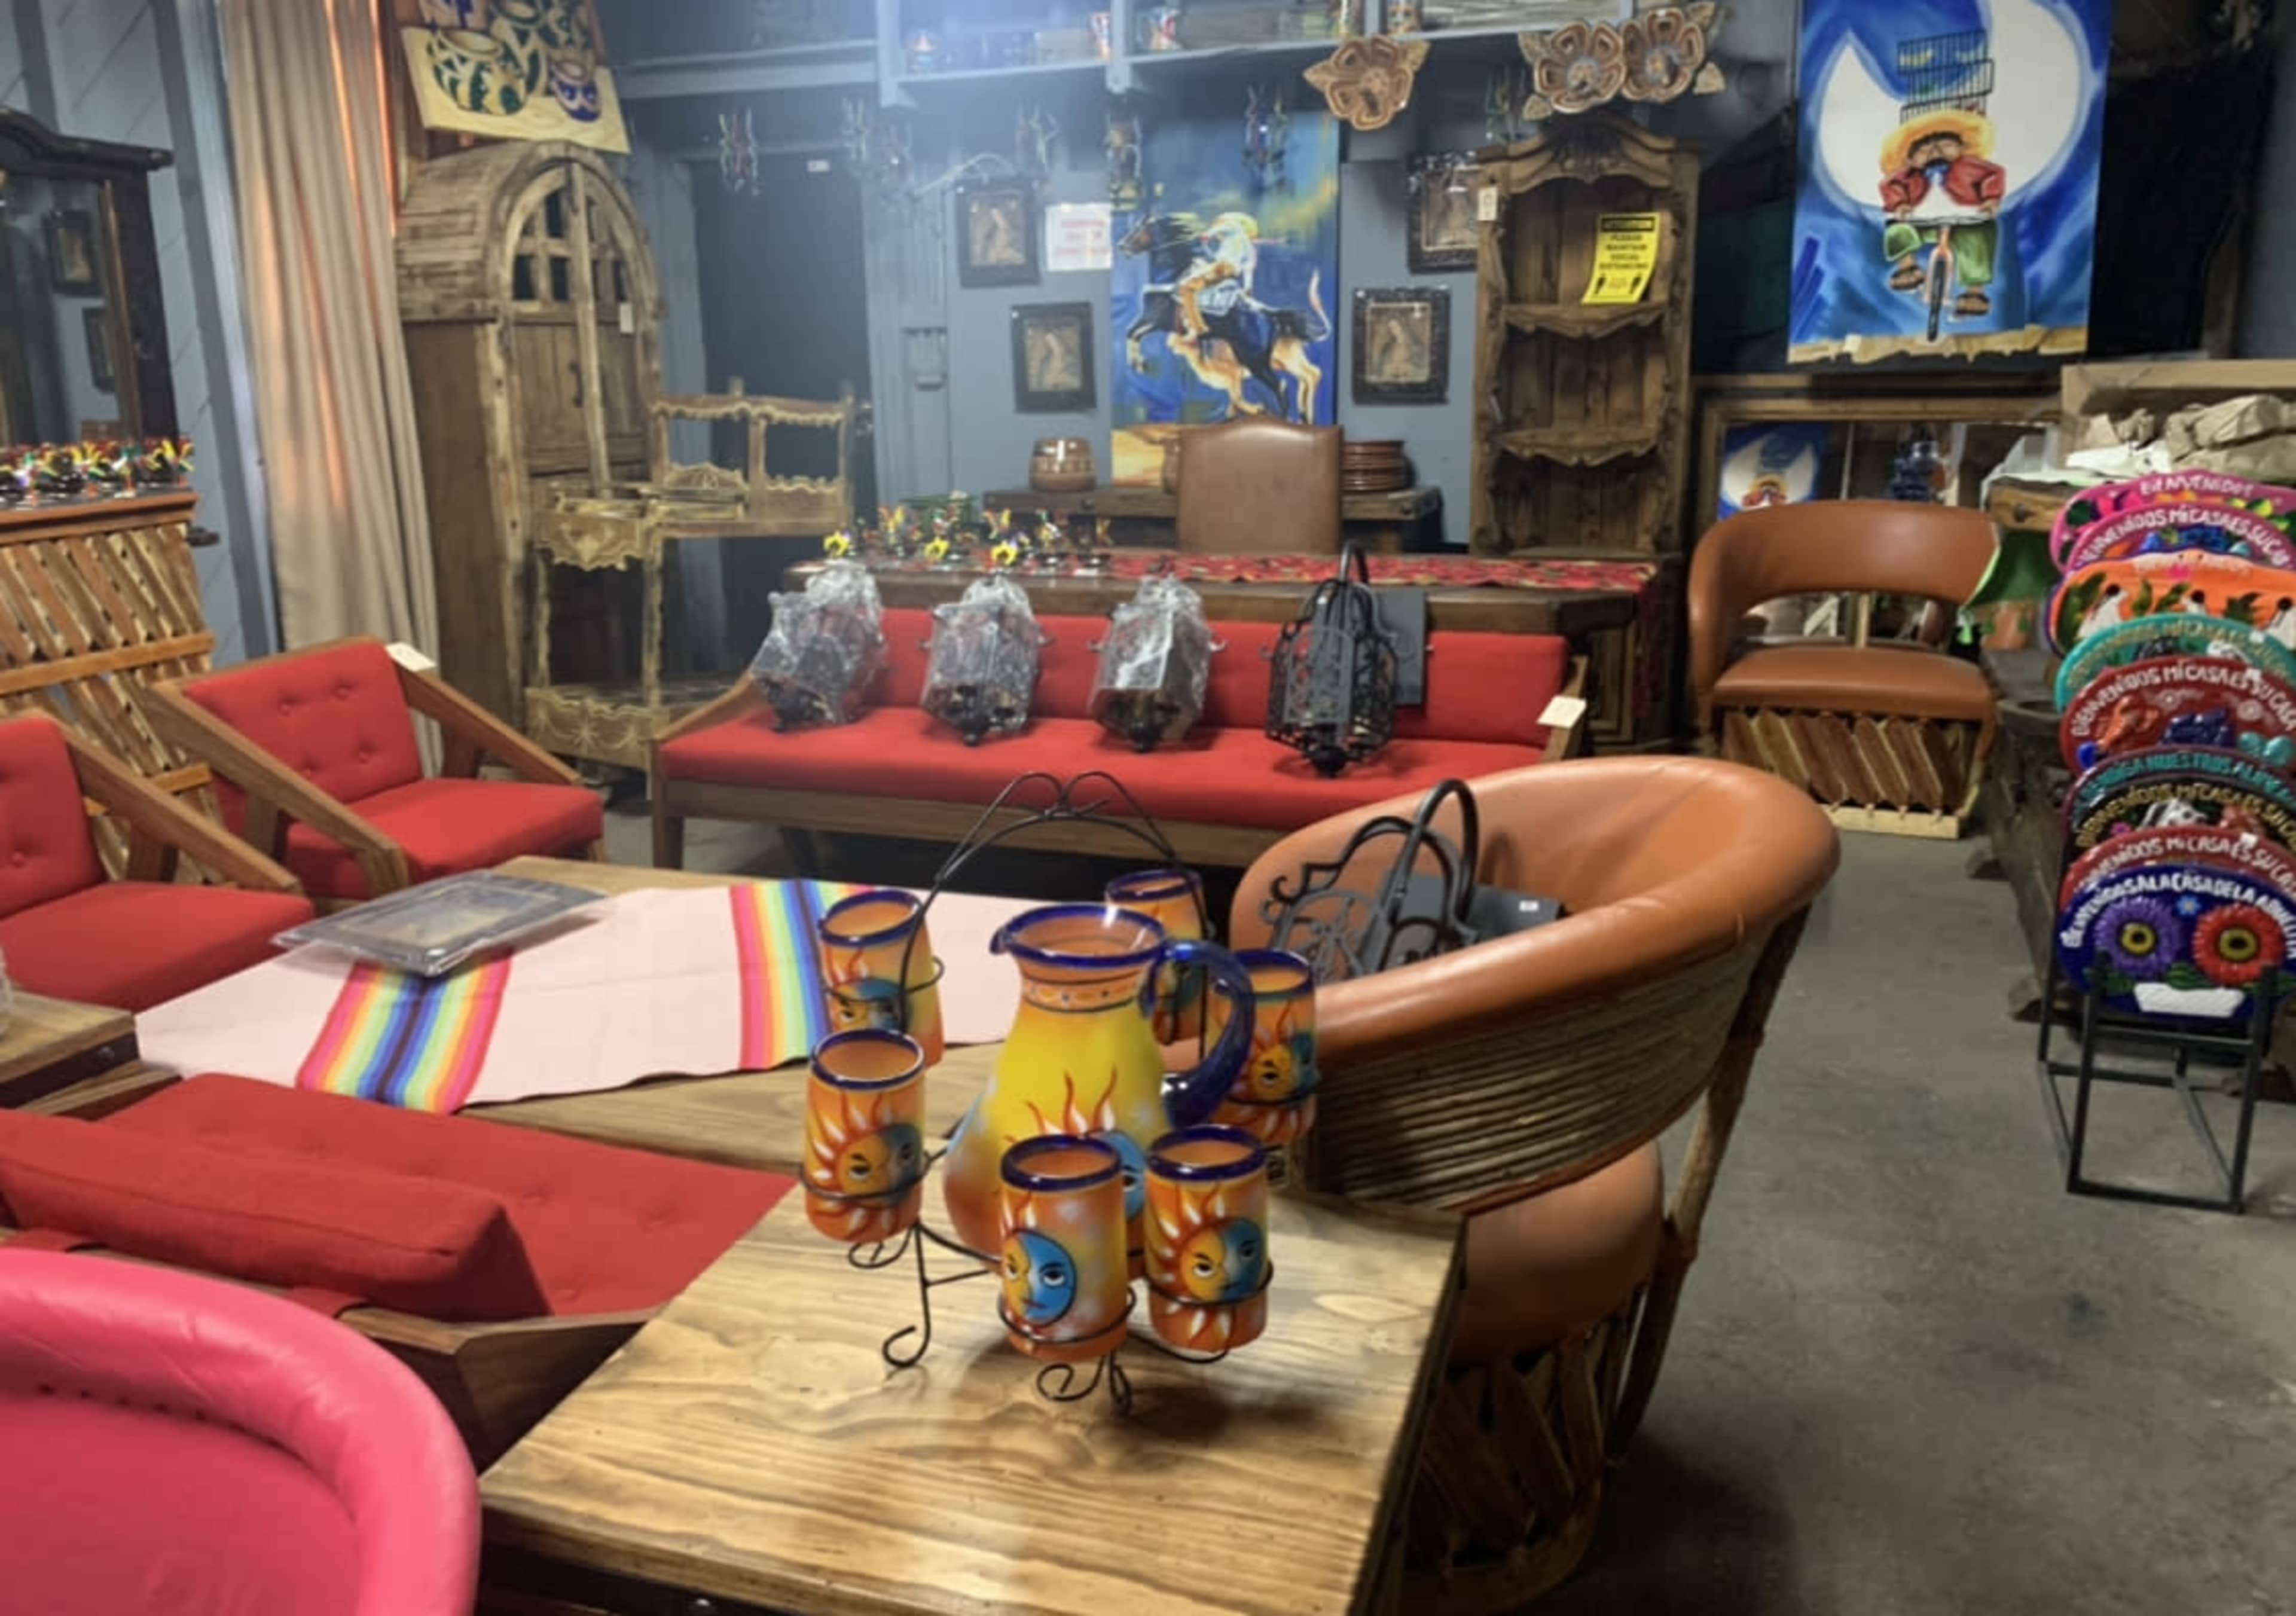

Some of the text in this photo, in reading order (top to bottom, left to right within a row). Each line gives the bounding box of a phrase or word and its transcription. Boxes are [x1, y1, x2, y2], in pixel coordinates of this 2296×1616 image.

[2077, 509, 2167, 566] IENVENIDOS
[2184, 664, 2229, 685] CASA
[2187, 836, 2230, 854] CASA
